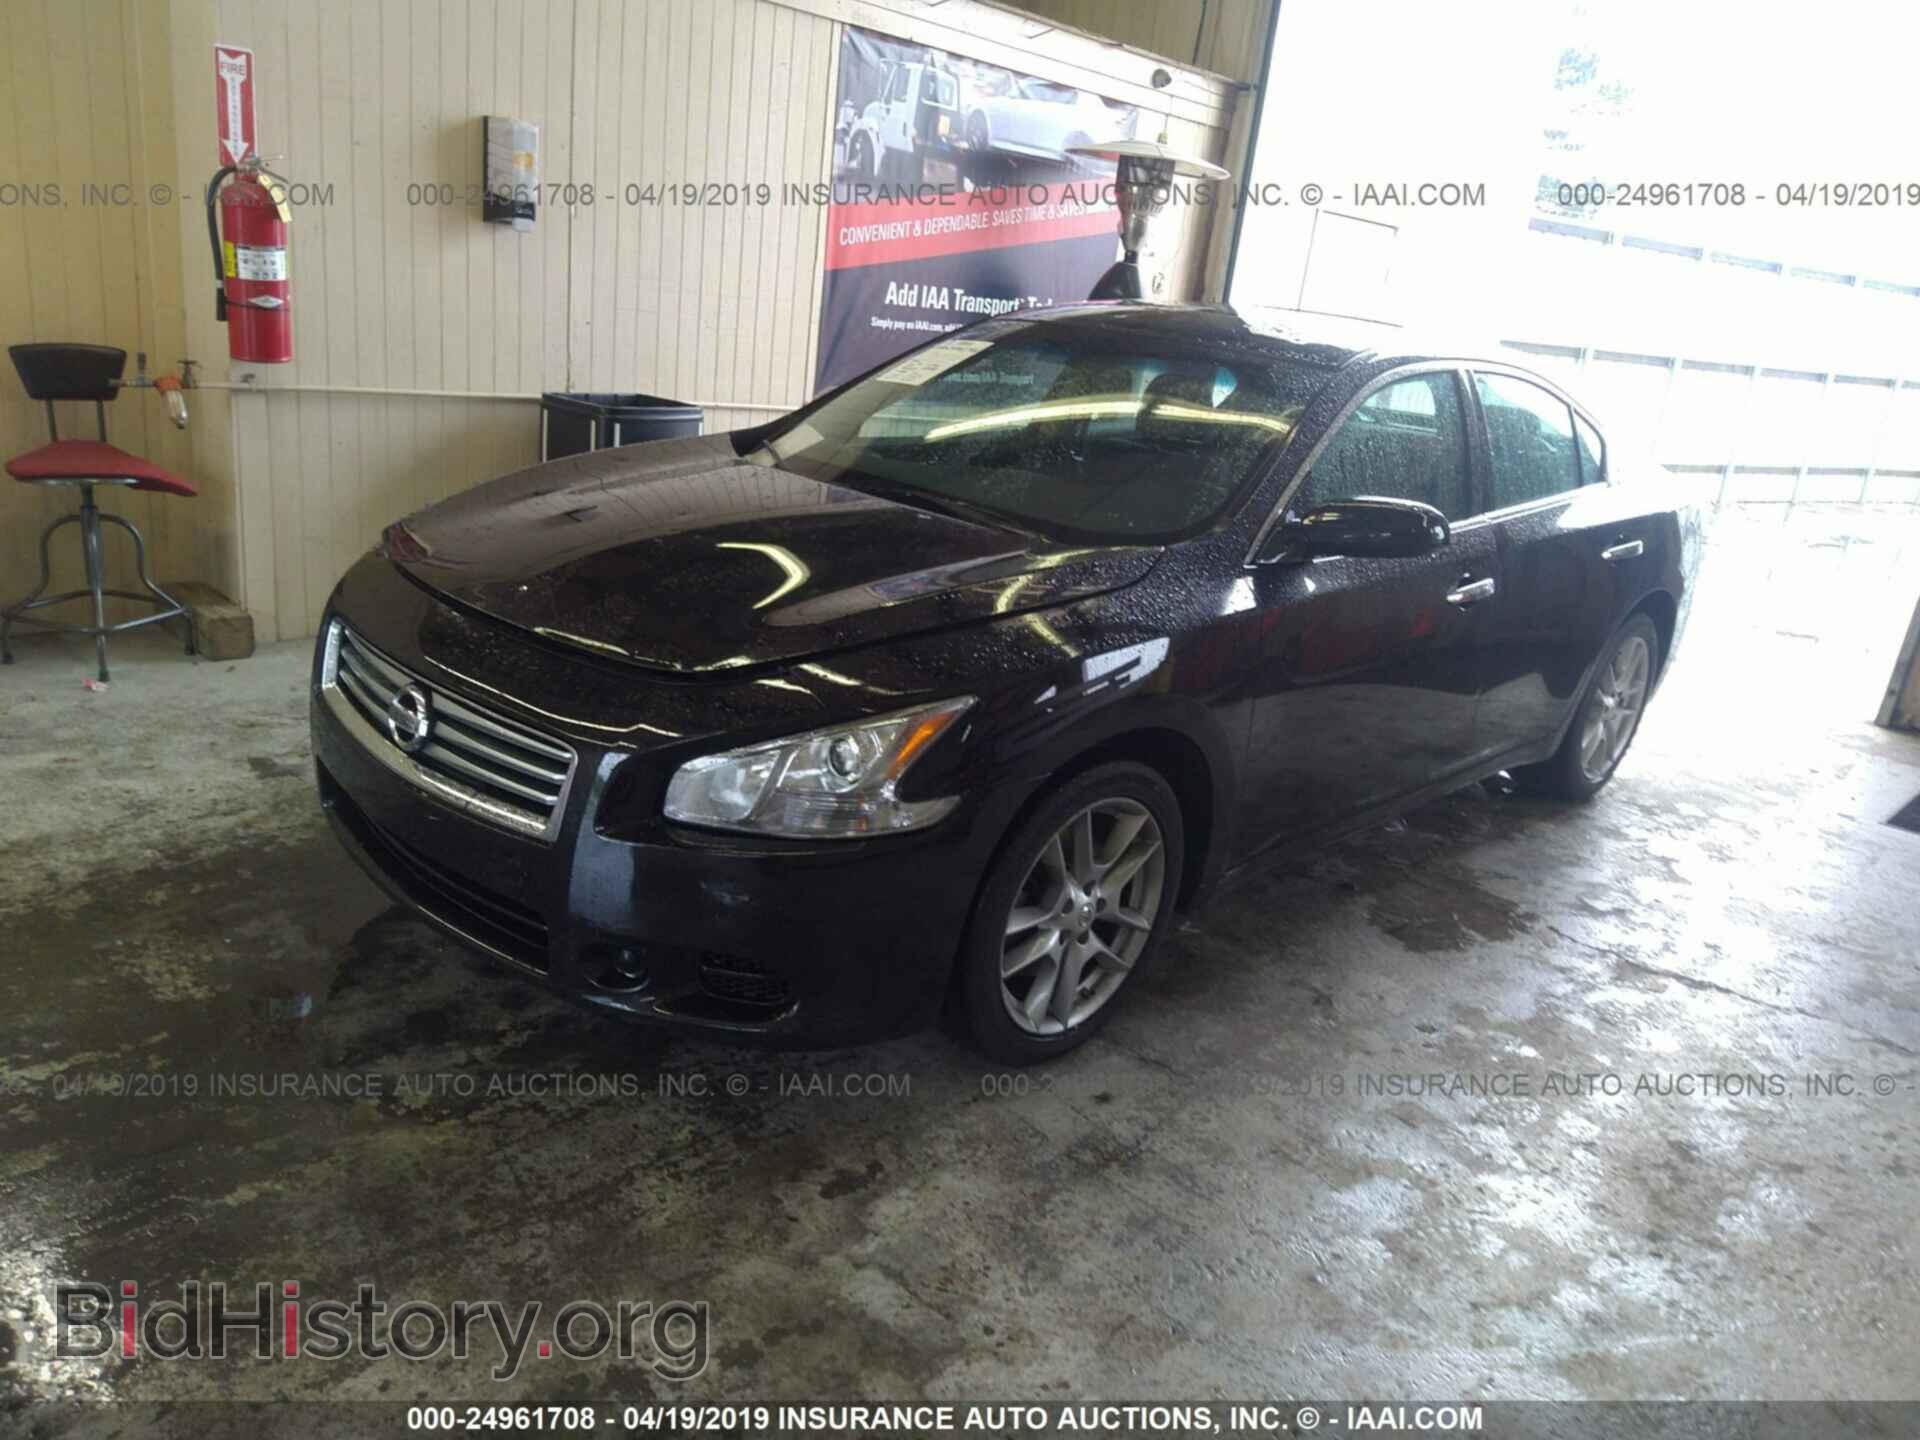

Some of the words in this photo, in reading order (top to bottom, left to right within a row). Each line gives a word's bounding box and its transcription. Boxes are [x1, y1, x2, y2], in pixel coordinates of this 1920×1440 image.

[220, 62, 246, 76] FIRE
[839, 219, 913, 247] CONVENIENT
[912, 219, 922, 238] &
[923, 211, 992, 237] DEPENDABLE
[991, 206, 1024, 228] SAVES
[884, 281, 919, 308] Add
[920, 285, 950, 311] IAA
